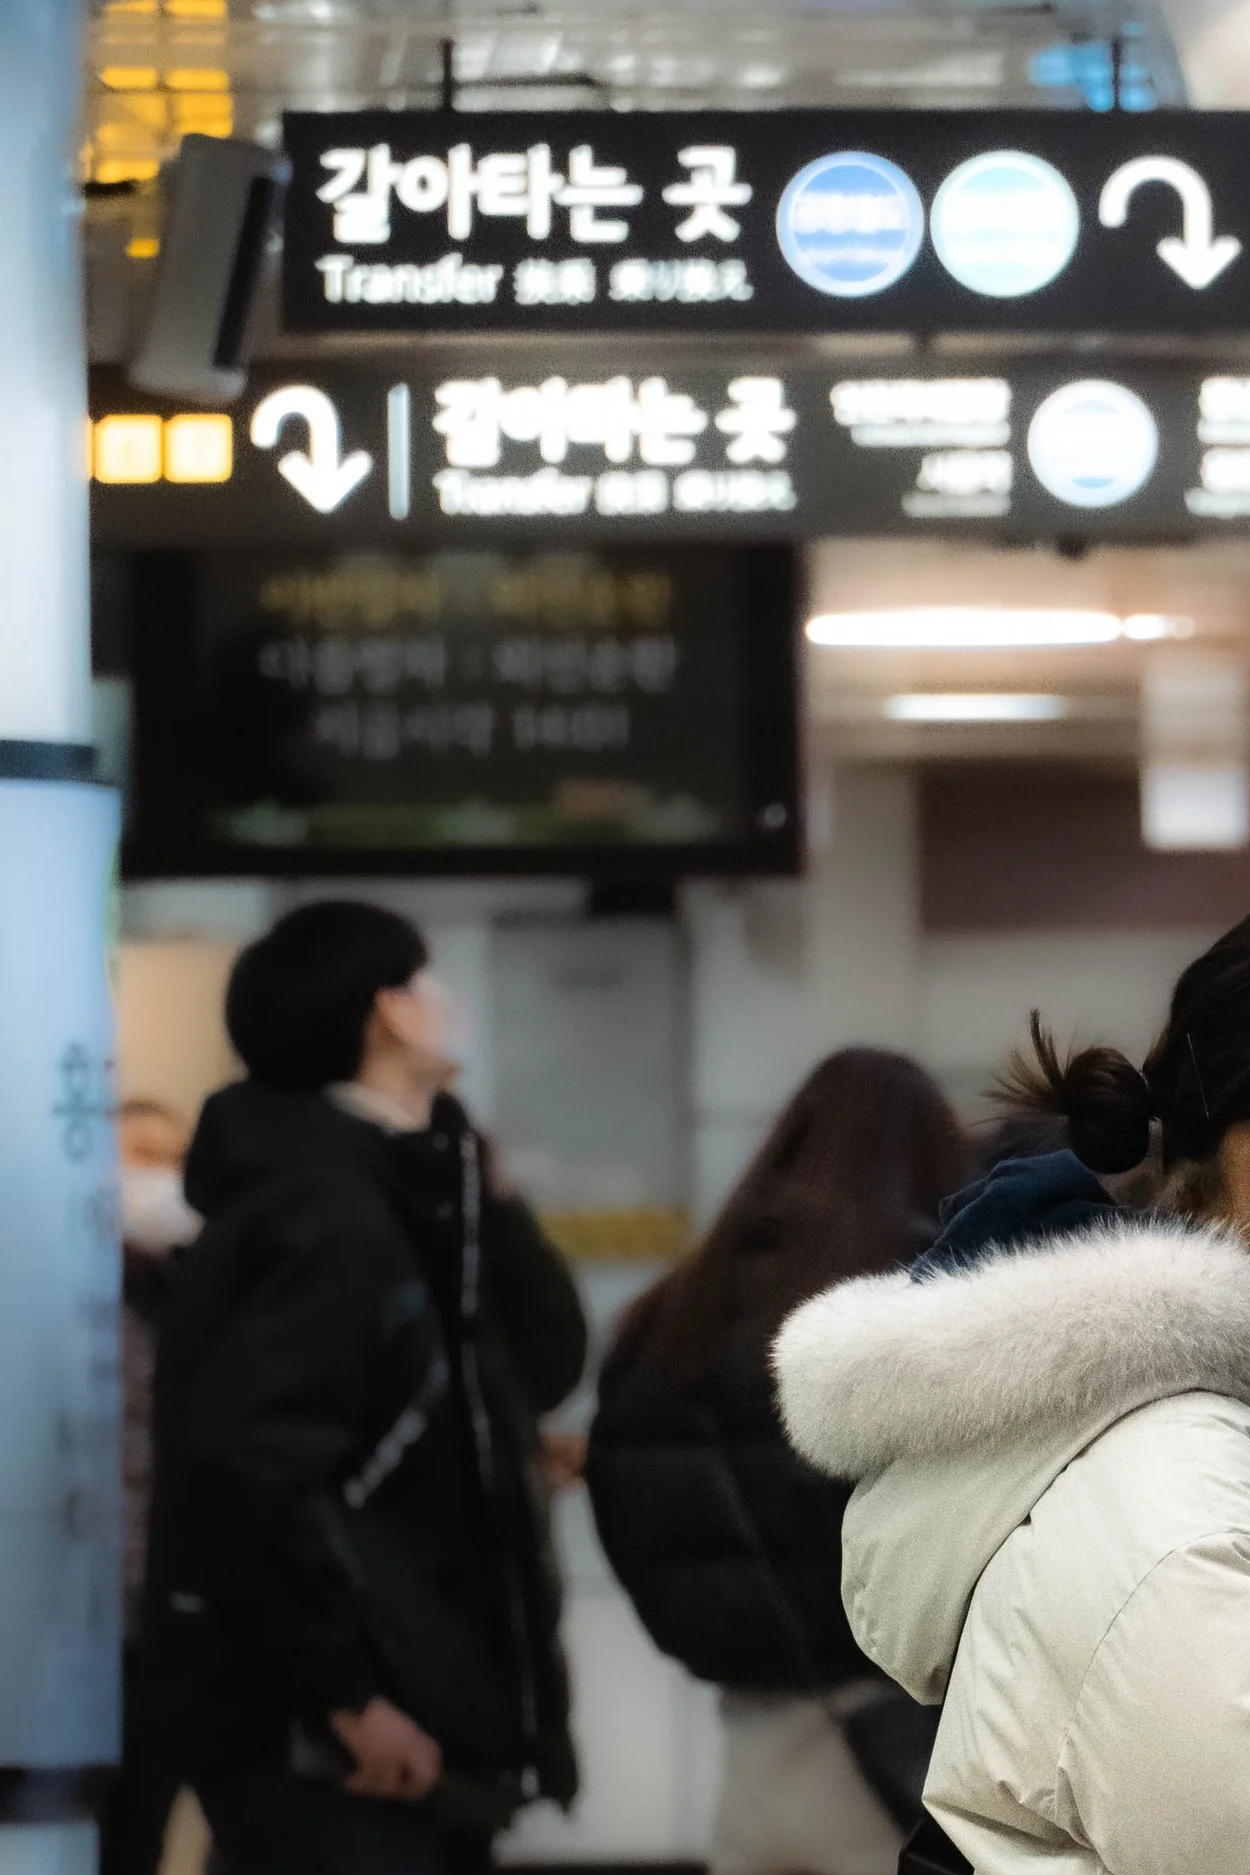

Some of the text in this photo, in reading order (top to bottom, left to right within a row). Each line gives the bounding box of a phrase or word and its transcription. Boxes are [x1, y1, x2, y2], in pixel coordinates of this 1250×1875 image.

[316, 143, 752, 245] 갈아타는 곳
[315, 252, 503, 305] Transfer
[714, 376, 797, 465] 곳
